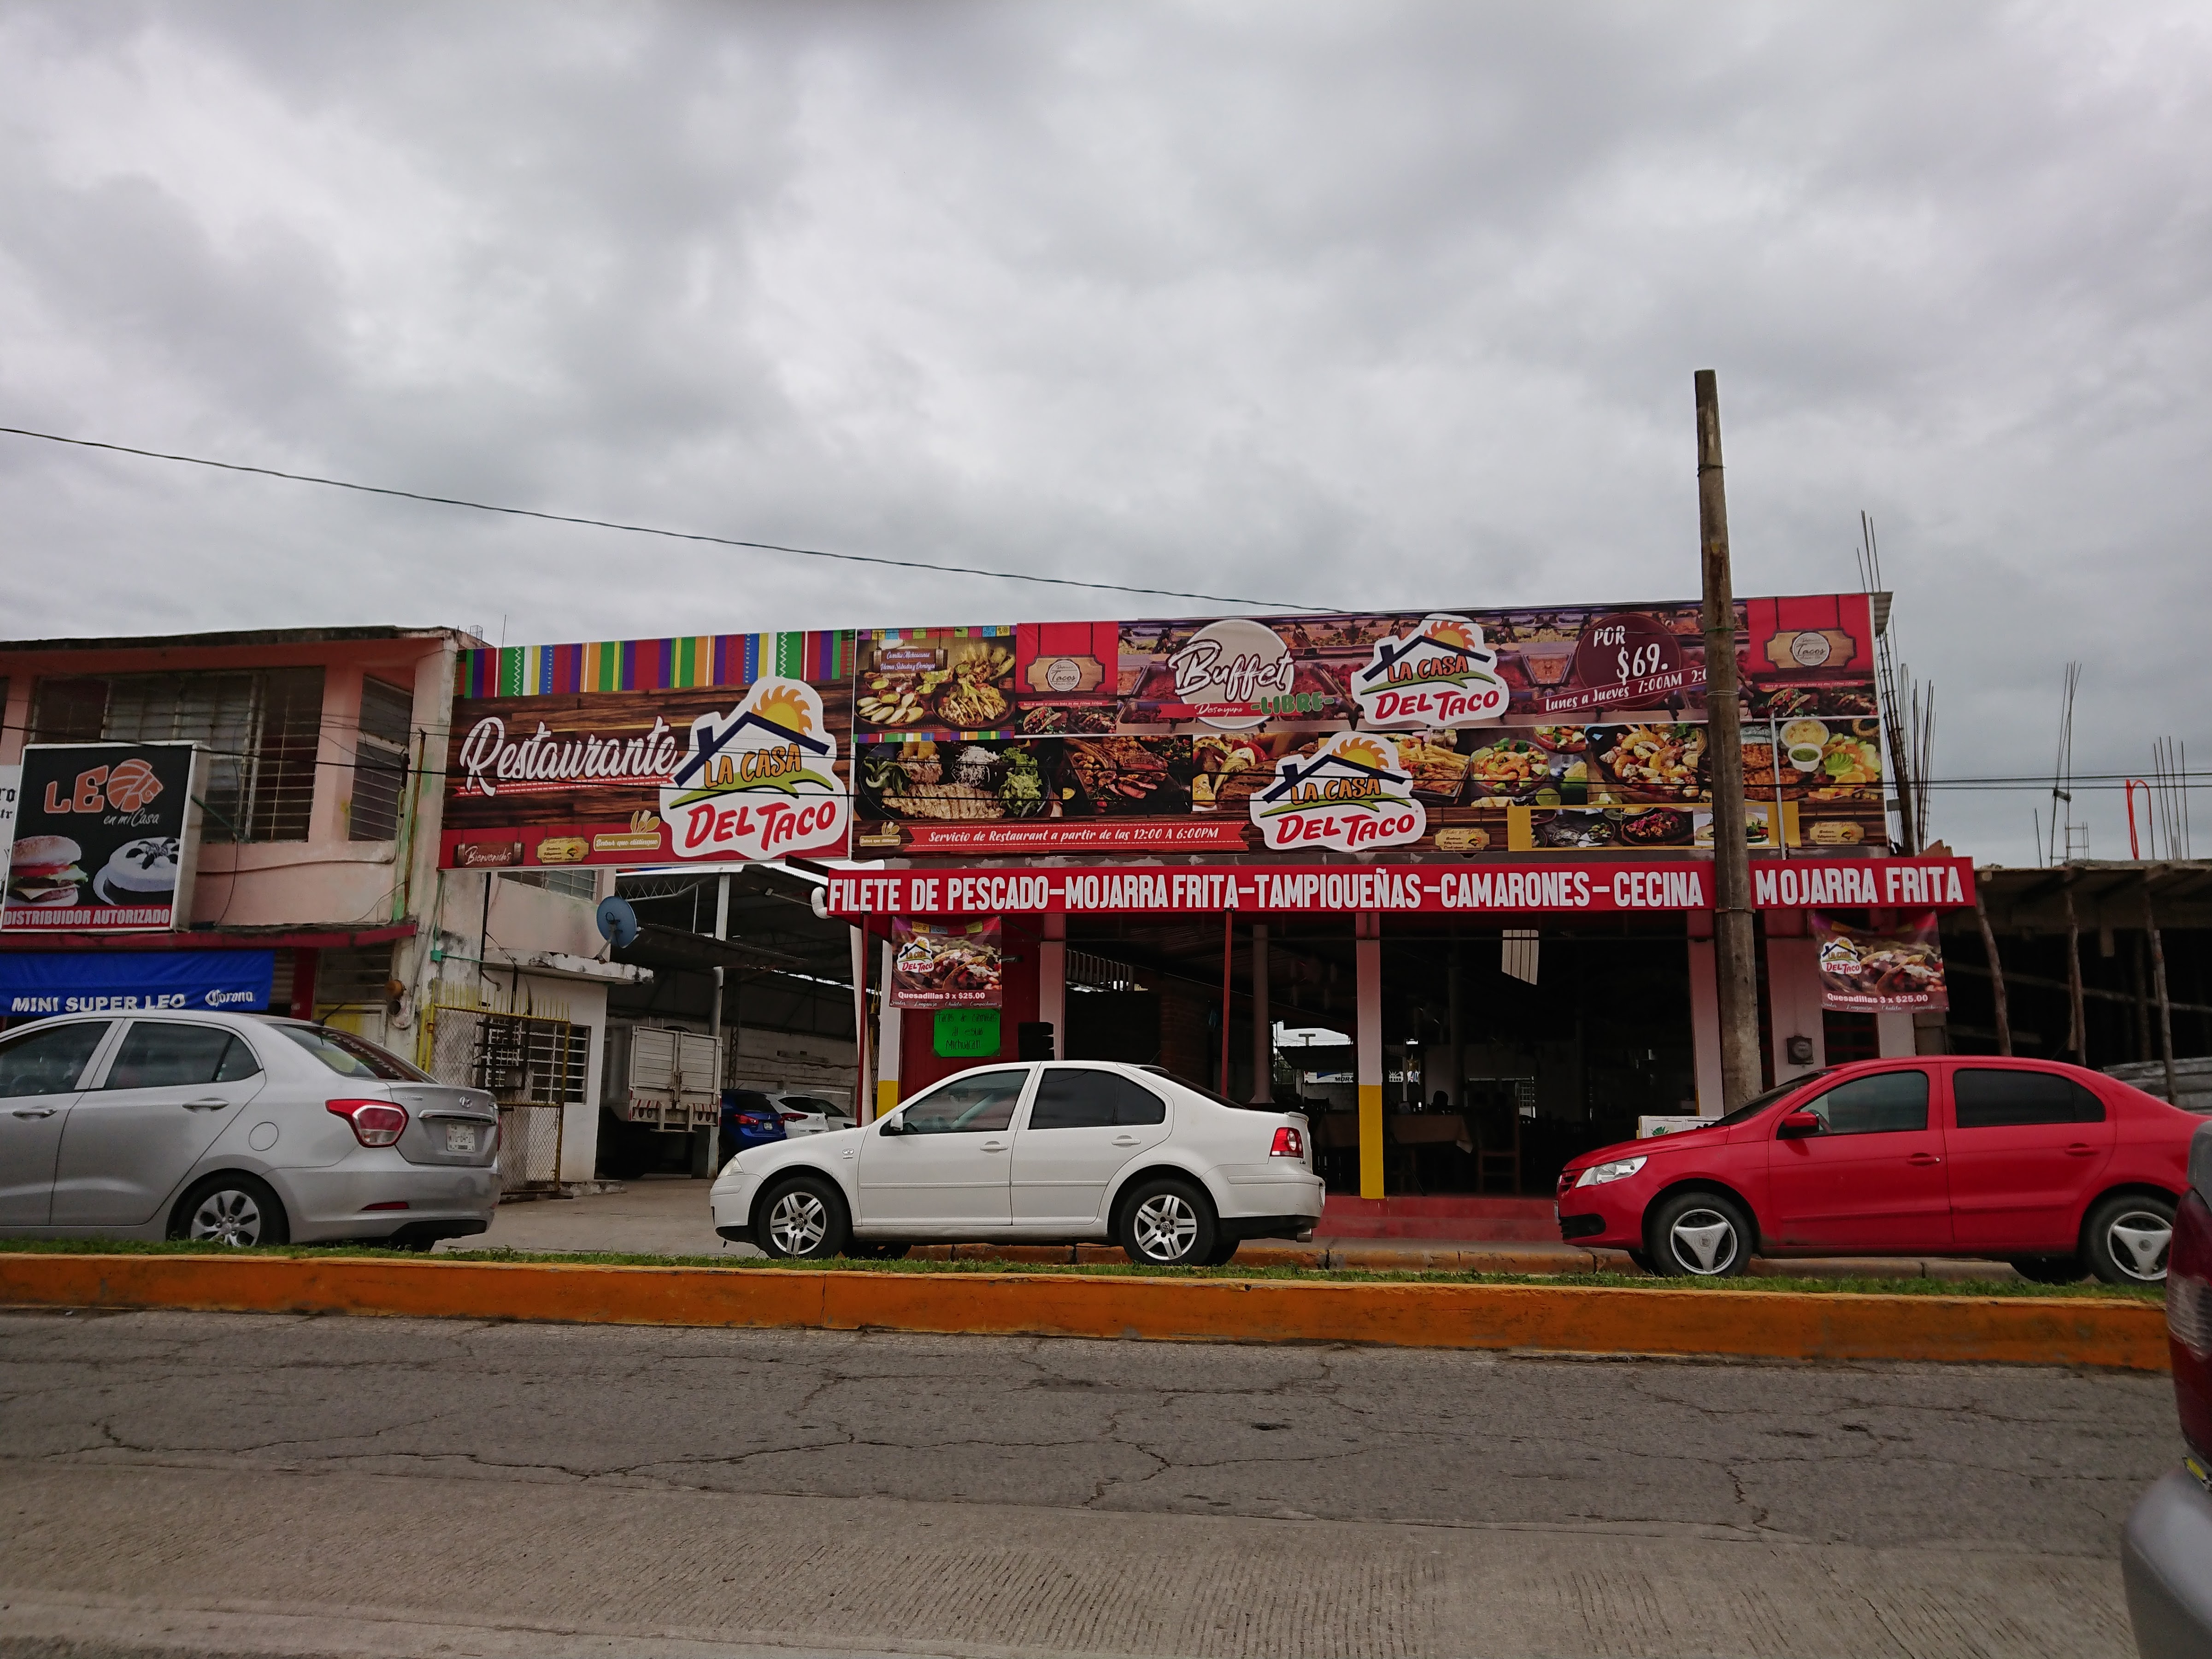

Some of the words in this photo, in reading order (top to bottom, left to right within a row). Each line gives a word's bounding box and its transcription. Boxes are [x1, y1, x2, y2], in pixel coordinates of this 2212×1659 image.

[1594, 625, 1626, 647] POR
[1796, 643, 1825, 656] Tacos
[1168, 640, 1294, 702] Buffet
[1387, 662, 1412, 683] LA
[1418, 654, 1469, 679] CASA
[1616, 643, 1668, 686] $69.
[1051, 670, 1076, 682] Tacos
[1546, 696, 1577, 712] Lunes
[1582, 694, 1588, 704] a
[1593, 686, 1630, 702] Jueves
[1638, 672, 1682, 694] 7:00AM
[1194, 703, 1243, 717] Desayuno
[1375, 692, 1433, 719] DEL
[1433, 690, 1499, 721] TACO
[459, 716, 678, 796] Restaurante
[704, 755, 734, 788] LA
[741, 743, 801, 782] CASA
[1290, 782, 1319, 805] LA
[1324, 777, 1381, 801] CASA
[103, 814, 115, 826] en
[685, 803, 756, 848] DEL
[756, 800, 836, 851] TACO
[1277, 815, 1341, 844] DEL
[1341, 814, 1415, 847] TACO
[929, 831, 971, 842] Servicio
[973, 831, 986, 841] de
[988, 830, 1048, 842] Restaurant
[1060, 829, 1096, 843] partir
[1099, 830, 1112, 840] de
[1115, 829, 1130, 841] las
[1134, 829, 1163, 839] 12:00
[1165, 829, 1172, 840] A
[1176, 827, 1219, 840] 6:00PM
[465, 845, 512, 865] Bienvenidos
[830, 878, 901, 911] FILETE
[911, 878, 939, 911] DE
[1754, 867, 1878, 906] MOJARRA
[1886, 866, 1964, 903] FRITA
[4, 910, 91, 925] DISTRIBUIDOR
[93, 909, 169, 924] AUTORIZADO
[902, 962, 917, 971] DEL
[918, 962, 933, 972] TACO
[1826, 962, 1842, 971] DEL
[11, 997, 59, 1012] MINI
[65, 995, 138, 1012] SUPER
[144, 993, 186, 1010] LEO
[205, 989, 253, 1007] Corona
[1827, 993, 1878, 1003] Quesadillas
[1896, 994, 1928, 1003] $25.00
